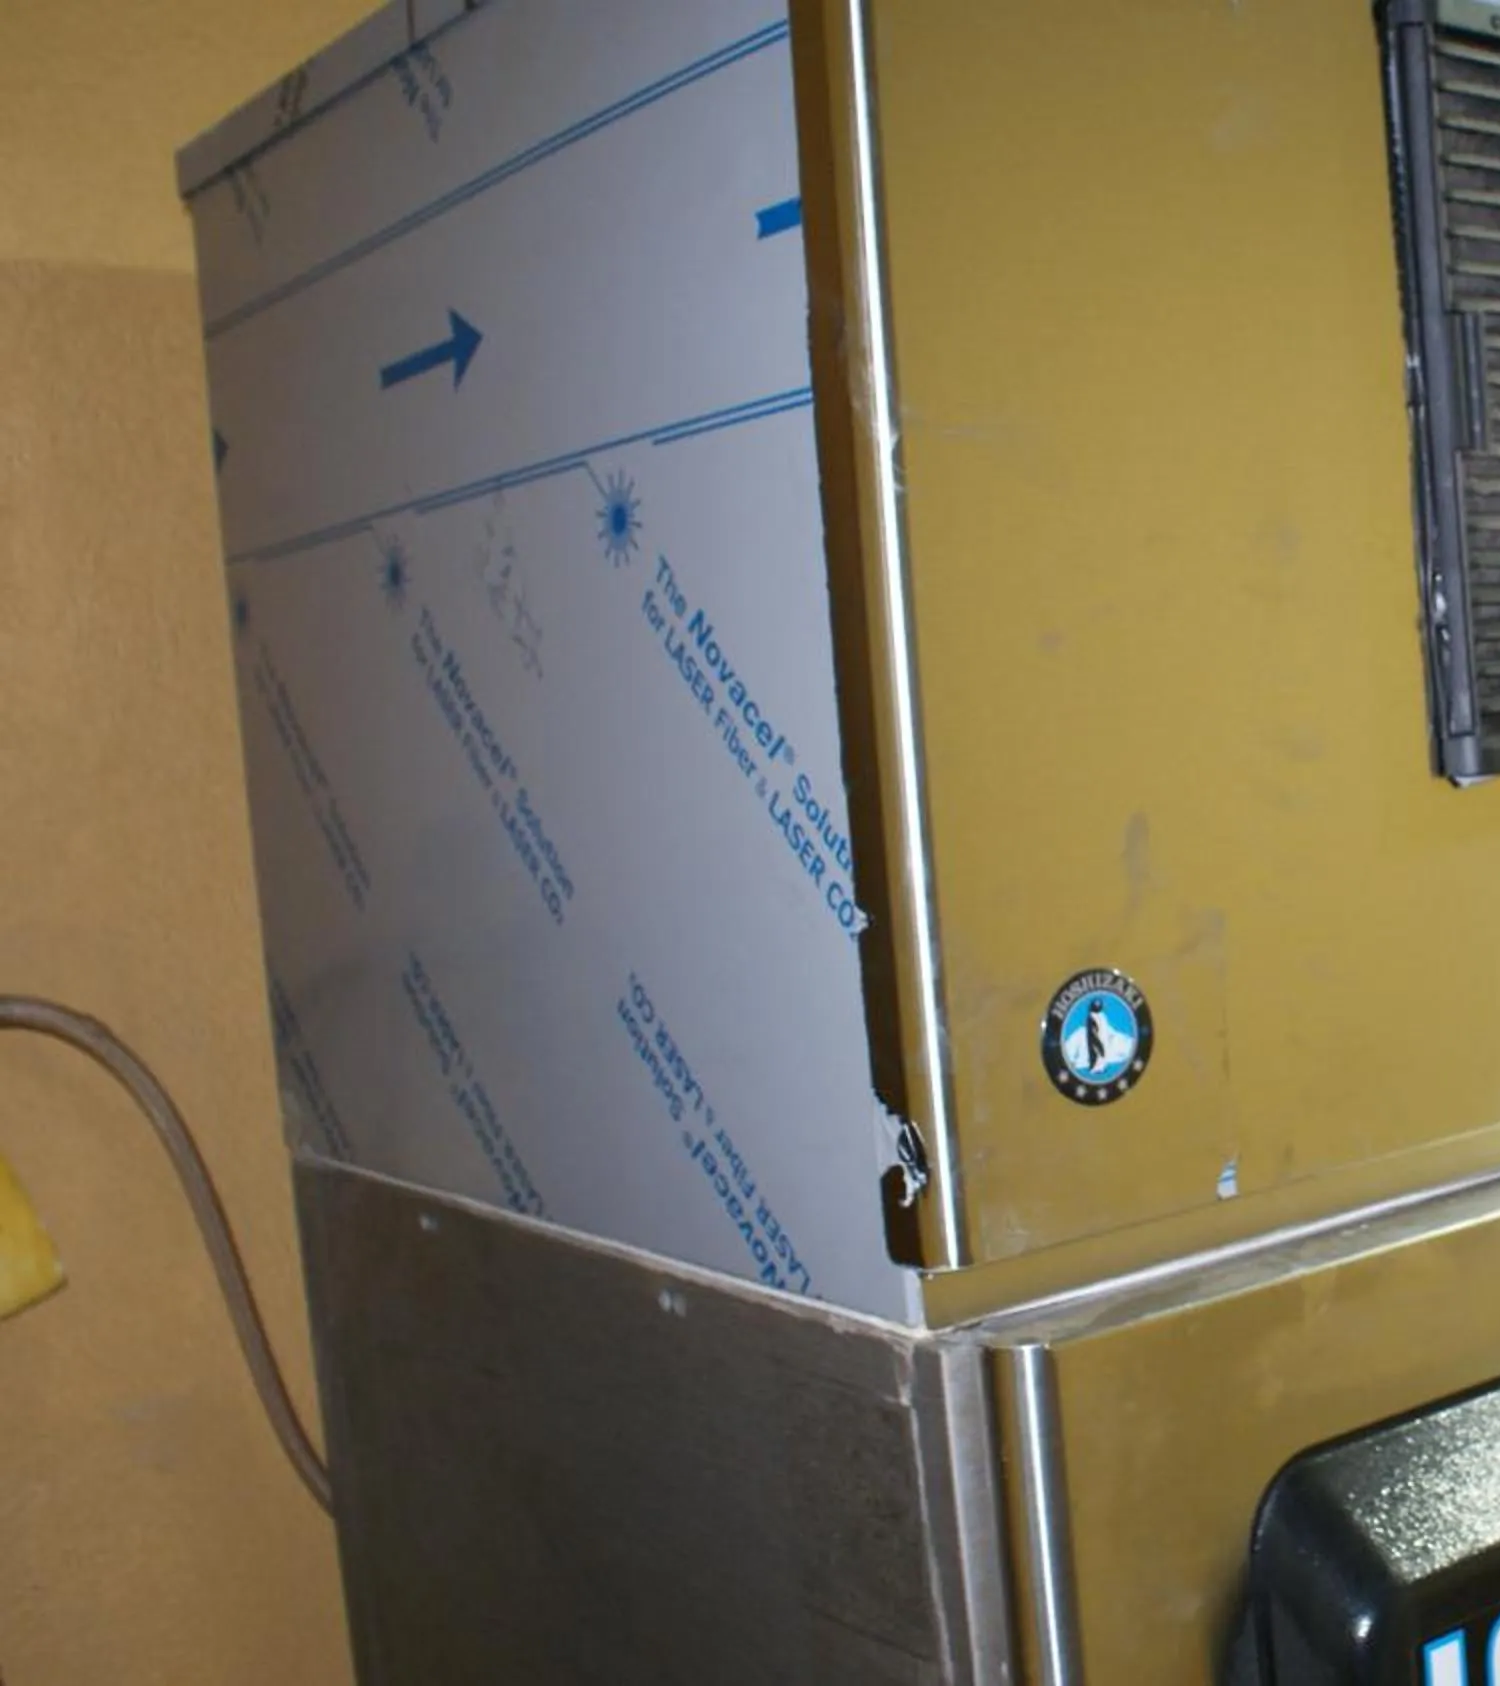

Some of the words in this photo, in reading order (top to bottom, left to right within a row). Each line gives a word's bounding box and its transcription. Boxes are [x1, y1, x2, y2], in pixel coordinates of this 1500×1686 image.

[656, 554, 687, 618] The
[641, 588, 666, 632] for
[663, 626, 715, 716] LASER
[714, 706, 757, 778] Fiber
[768, 789, 826, 889] LASER
[1051, 972, 1144, 1020] HOSHIZAKI
[654, 1018, 704, 1112] LASER
[714, 1128, 756, 1199] Fiber
[756, 1197, 811, 1295] LASER
